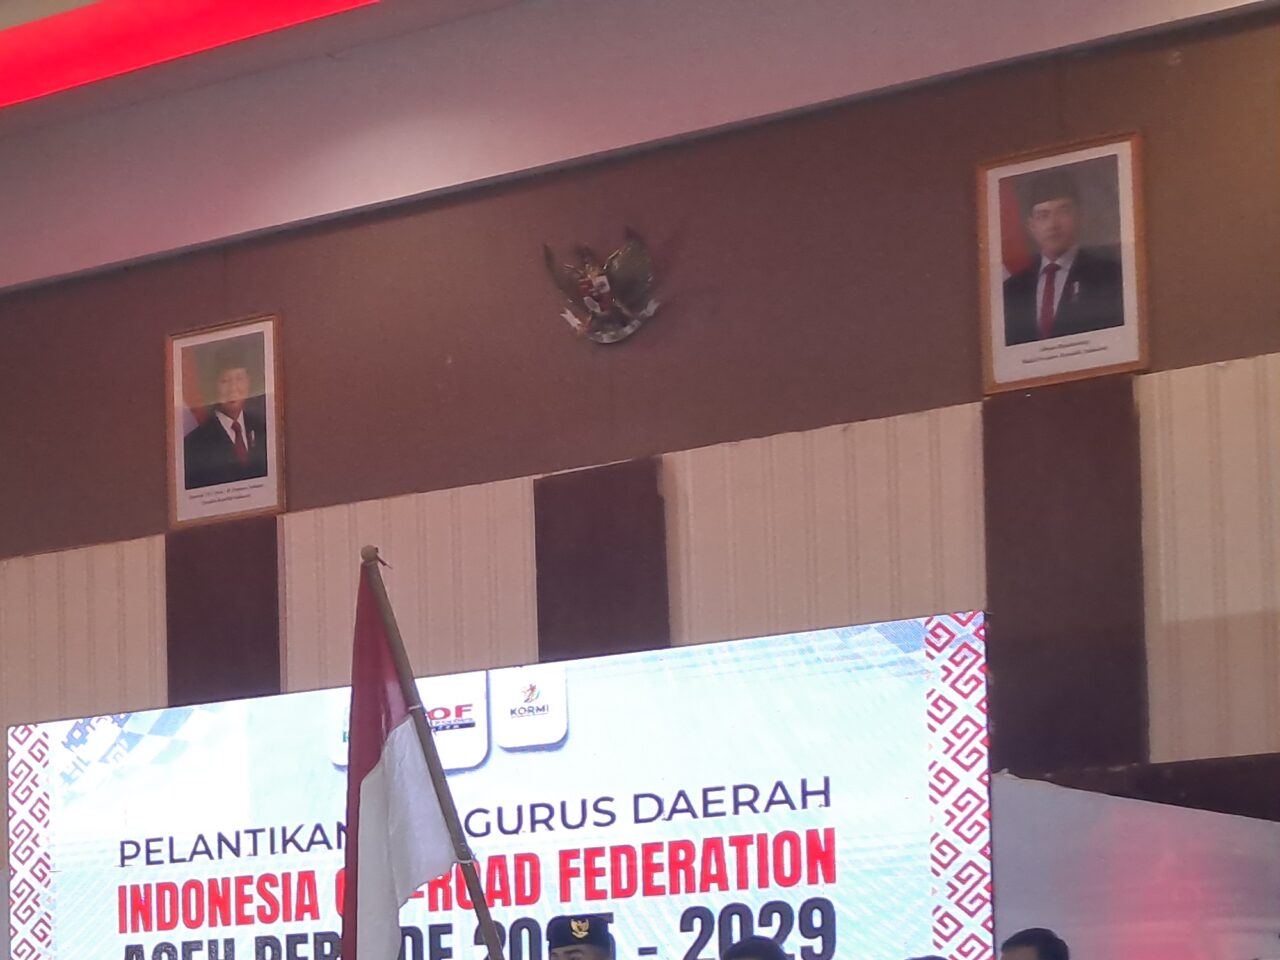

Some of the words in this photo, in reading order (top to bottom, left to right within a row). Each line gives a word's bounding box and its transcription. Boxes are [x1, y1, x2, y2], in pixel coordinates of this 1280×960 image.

[425, 703, 473, 720] OF
[510, 704, 549, 716] KORMI
[464, 796, 617, 838] GURUS
[632, 775, 832, 824] DAERAH
[118, 869, 320, 934] INDONESIA
[558, 827, 837, 903] FEDERATION
